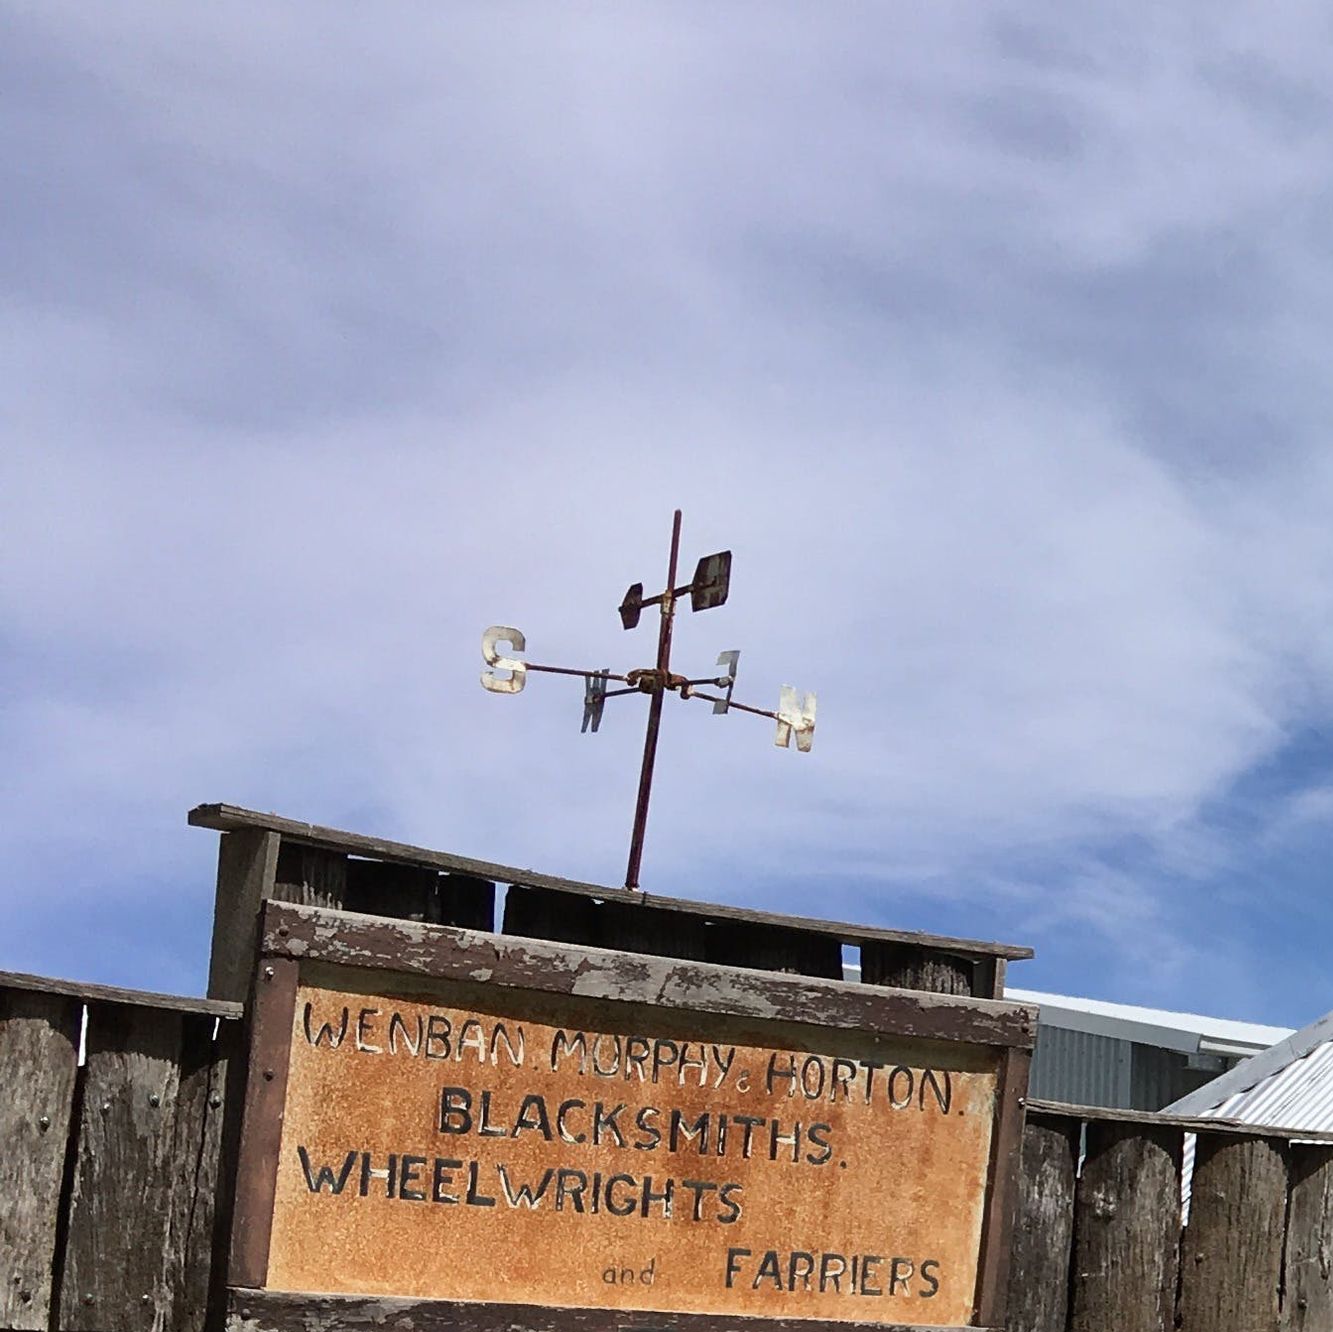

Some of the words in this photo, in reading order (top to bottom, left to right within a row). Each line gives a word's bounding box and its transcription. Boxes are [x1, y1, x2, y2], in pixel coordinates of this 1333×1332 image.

[550, 1028, 736, 1089] MURPHY
[438, 1086, 848, 1170] BLACKSMITHS.
[296, 1145, 744, 1225] WHEELWRIGHTS
[601, 1257, 657, 1287] and
[724, 1247, 940, 1299] FARRIERS
